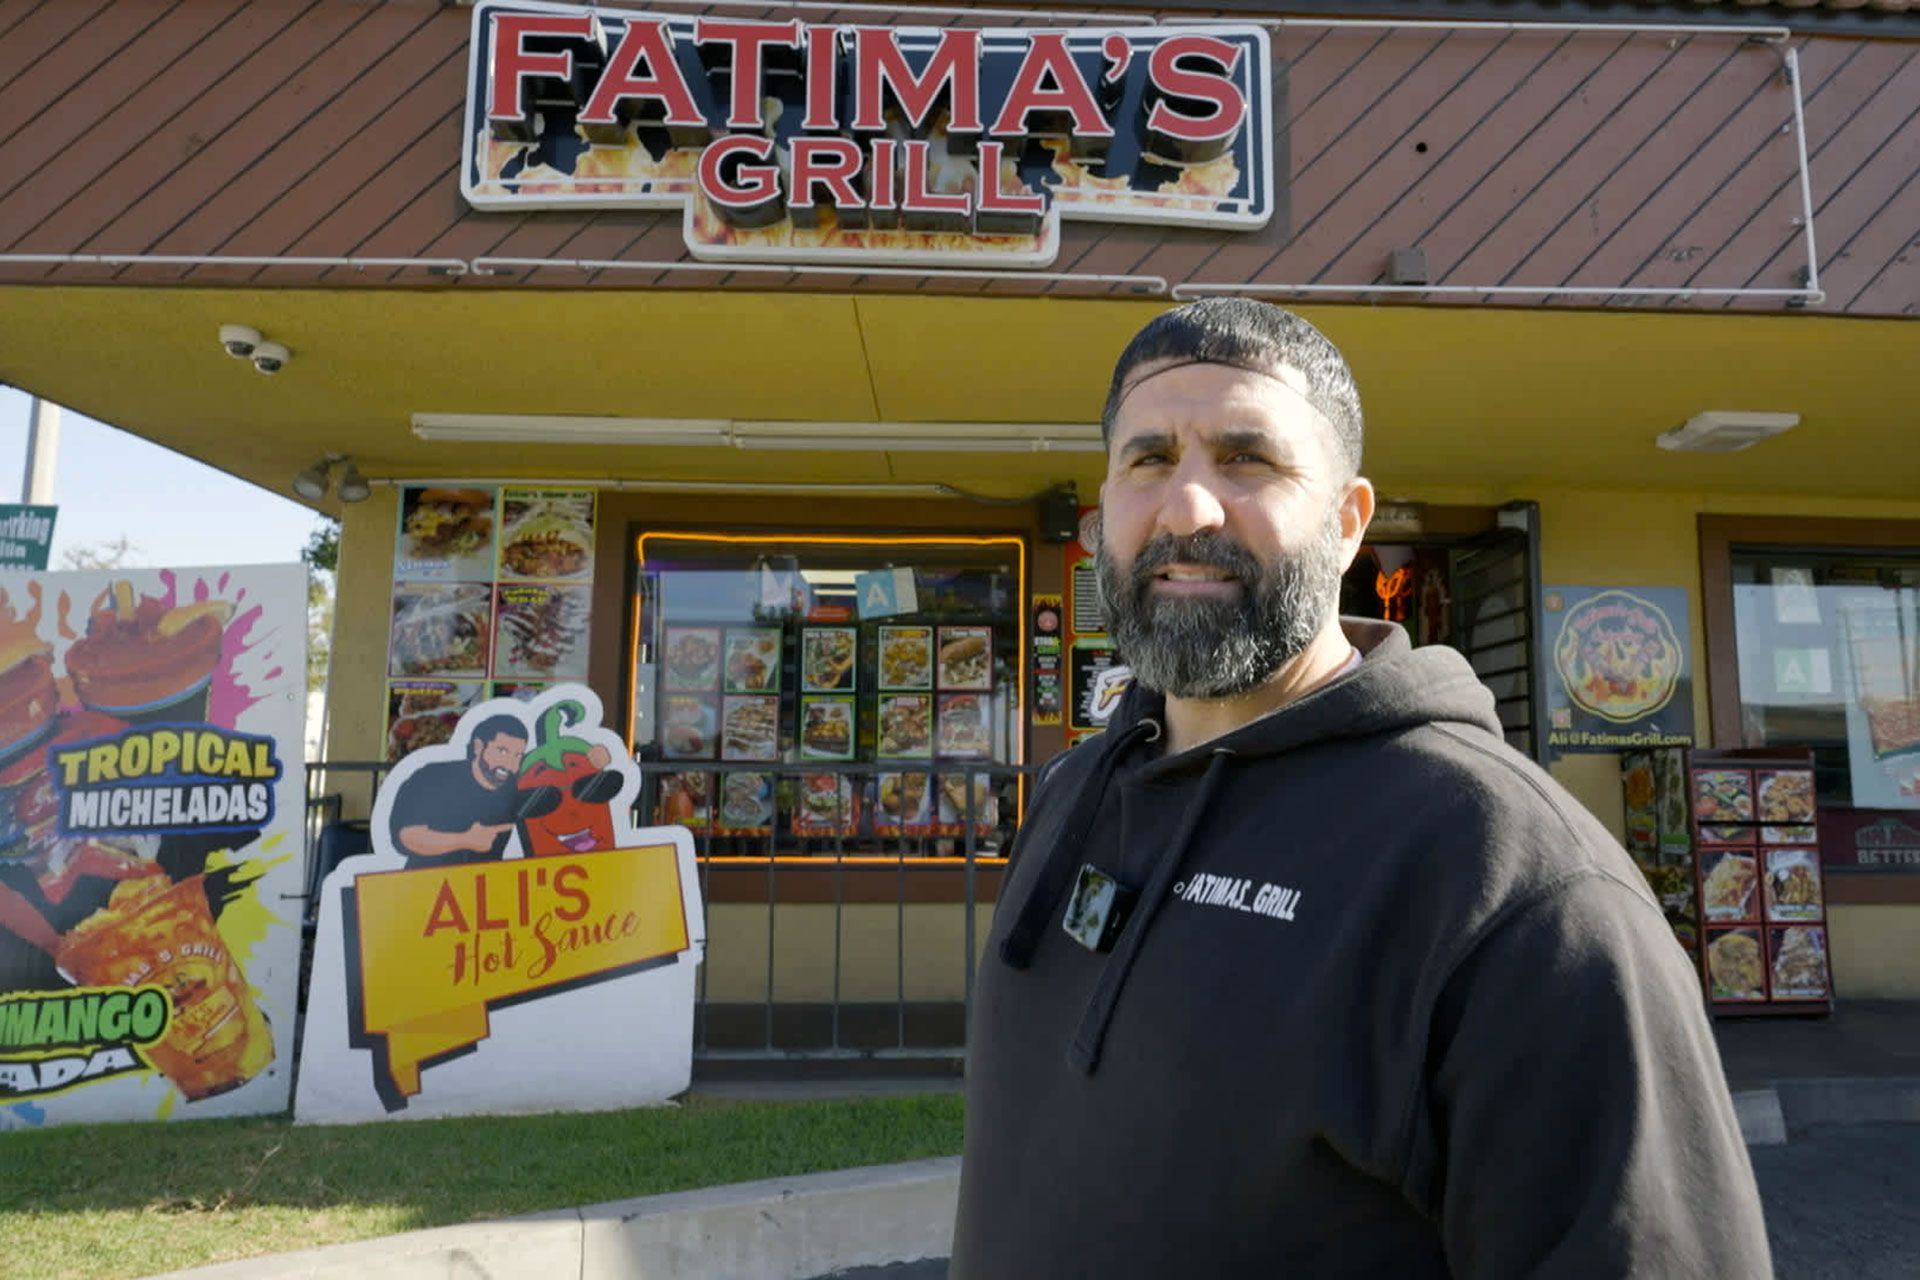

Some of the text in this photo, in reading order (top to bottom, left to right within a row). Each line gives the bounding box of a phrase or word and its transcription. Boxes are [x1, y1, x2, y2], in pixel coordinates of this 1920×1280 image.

[487, 14, 1250, 140] FATIMA'S
[697, 134, 1047, 216] GRILL
[58, 731, 277, 785] TROPICAL
[68, 784, 268, 829] MICHELADAS
[423, 864, 591, 938] ALI'S
[449, 908, 641, 986] Hot Sauce
